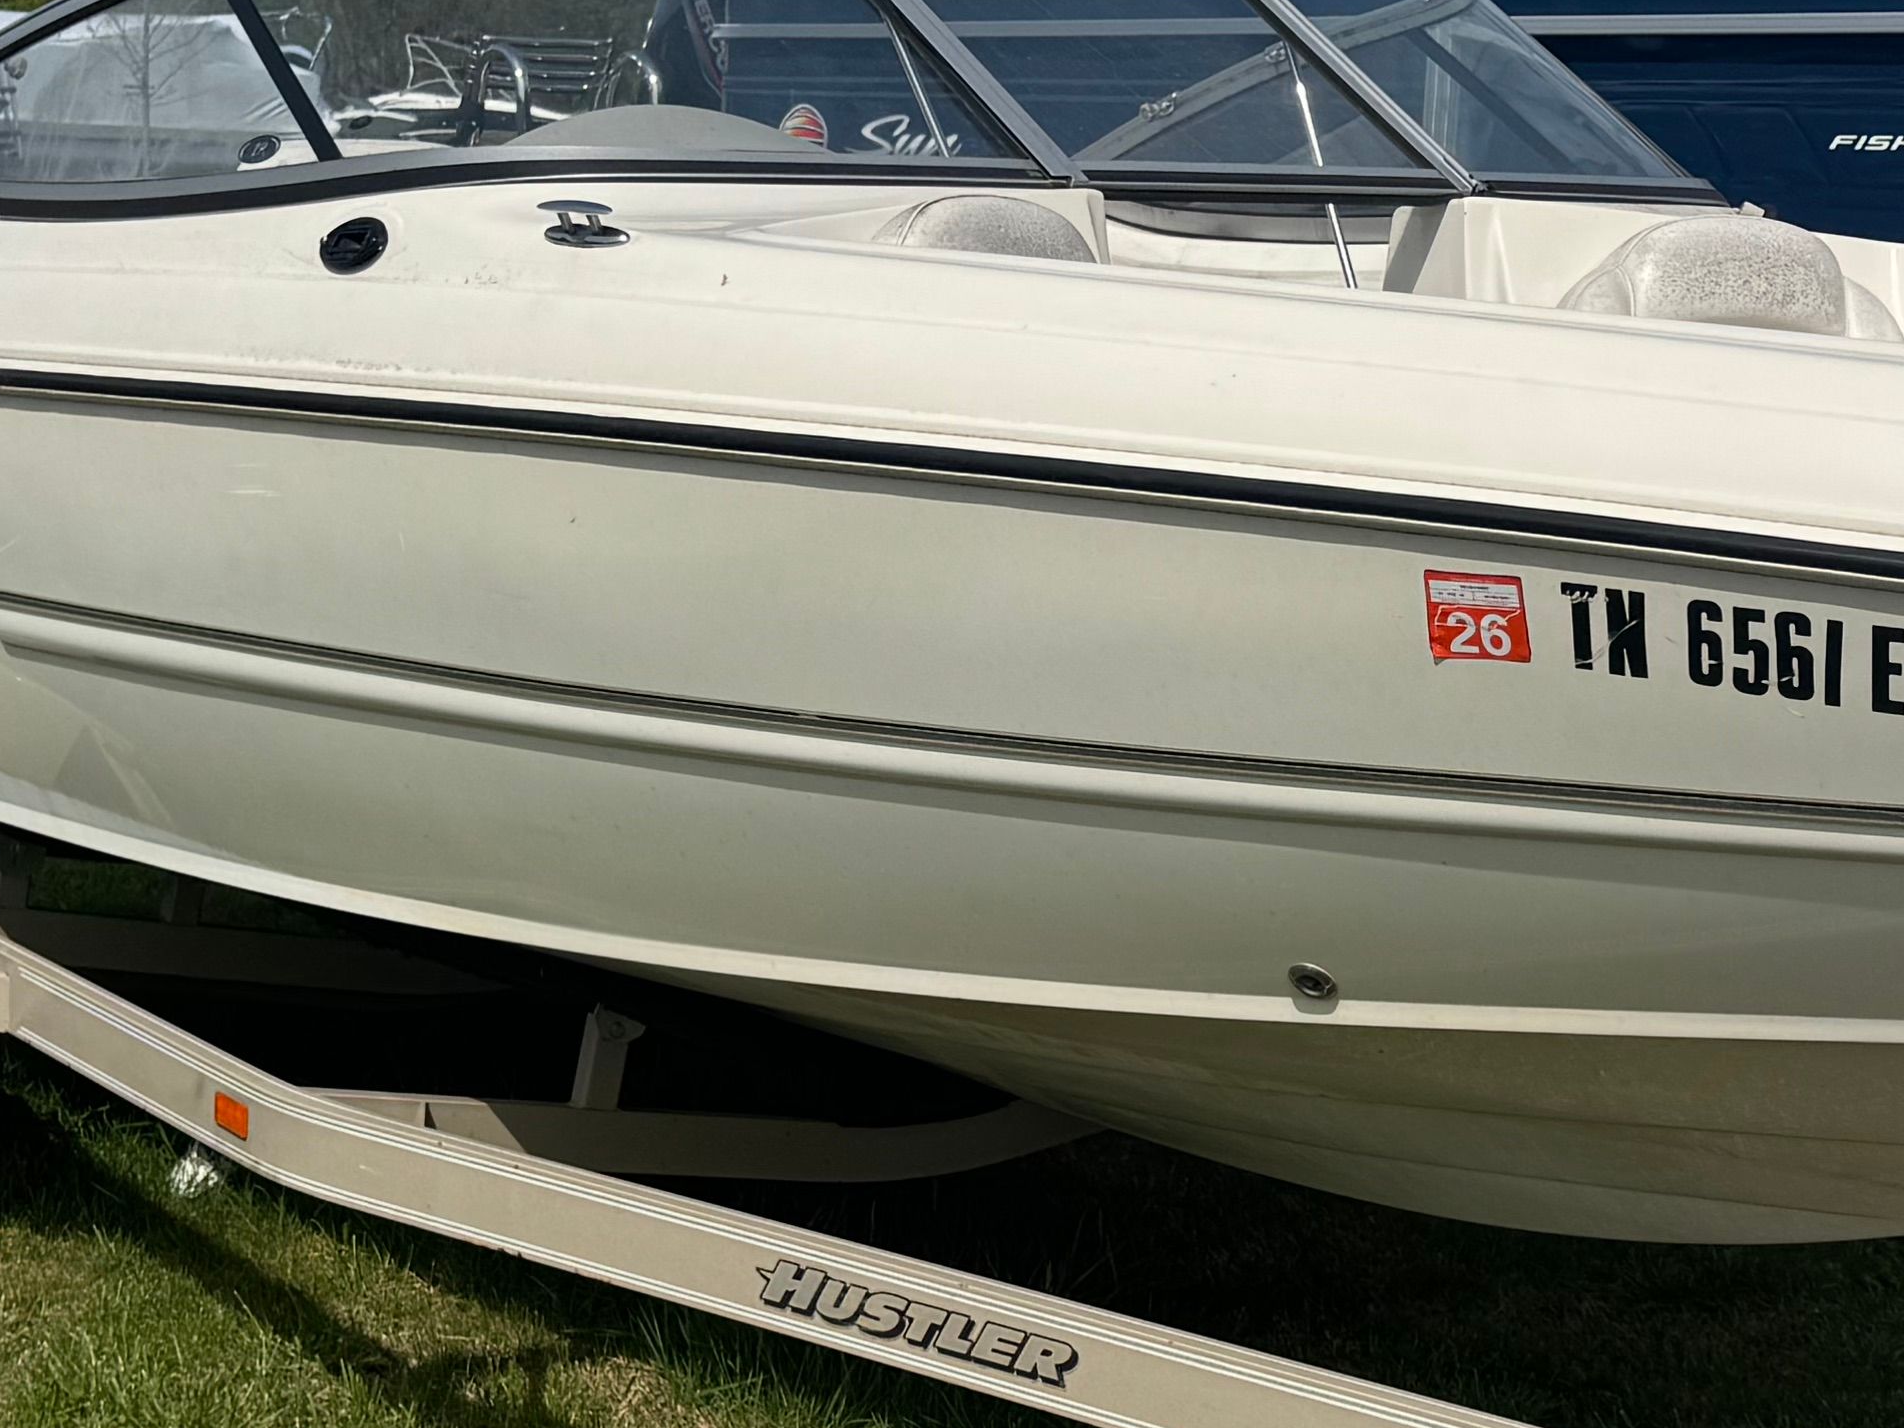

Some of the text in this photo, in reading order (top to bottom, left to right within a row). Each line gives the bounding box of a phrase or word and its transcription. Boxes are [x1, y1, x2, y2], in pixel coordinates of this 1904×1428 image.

[1446, 611, 1511, 657] 26
[1560, 582, 1649, 679] TN
[1687, 599, 1844, 708] 6561
[756, 1259, 1079, 1388] HUSTLER
